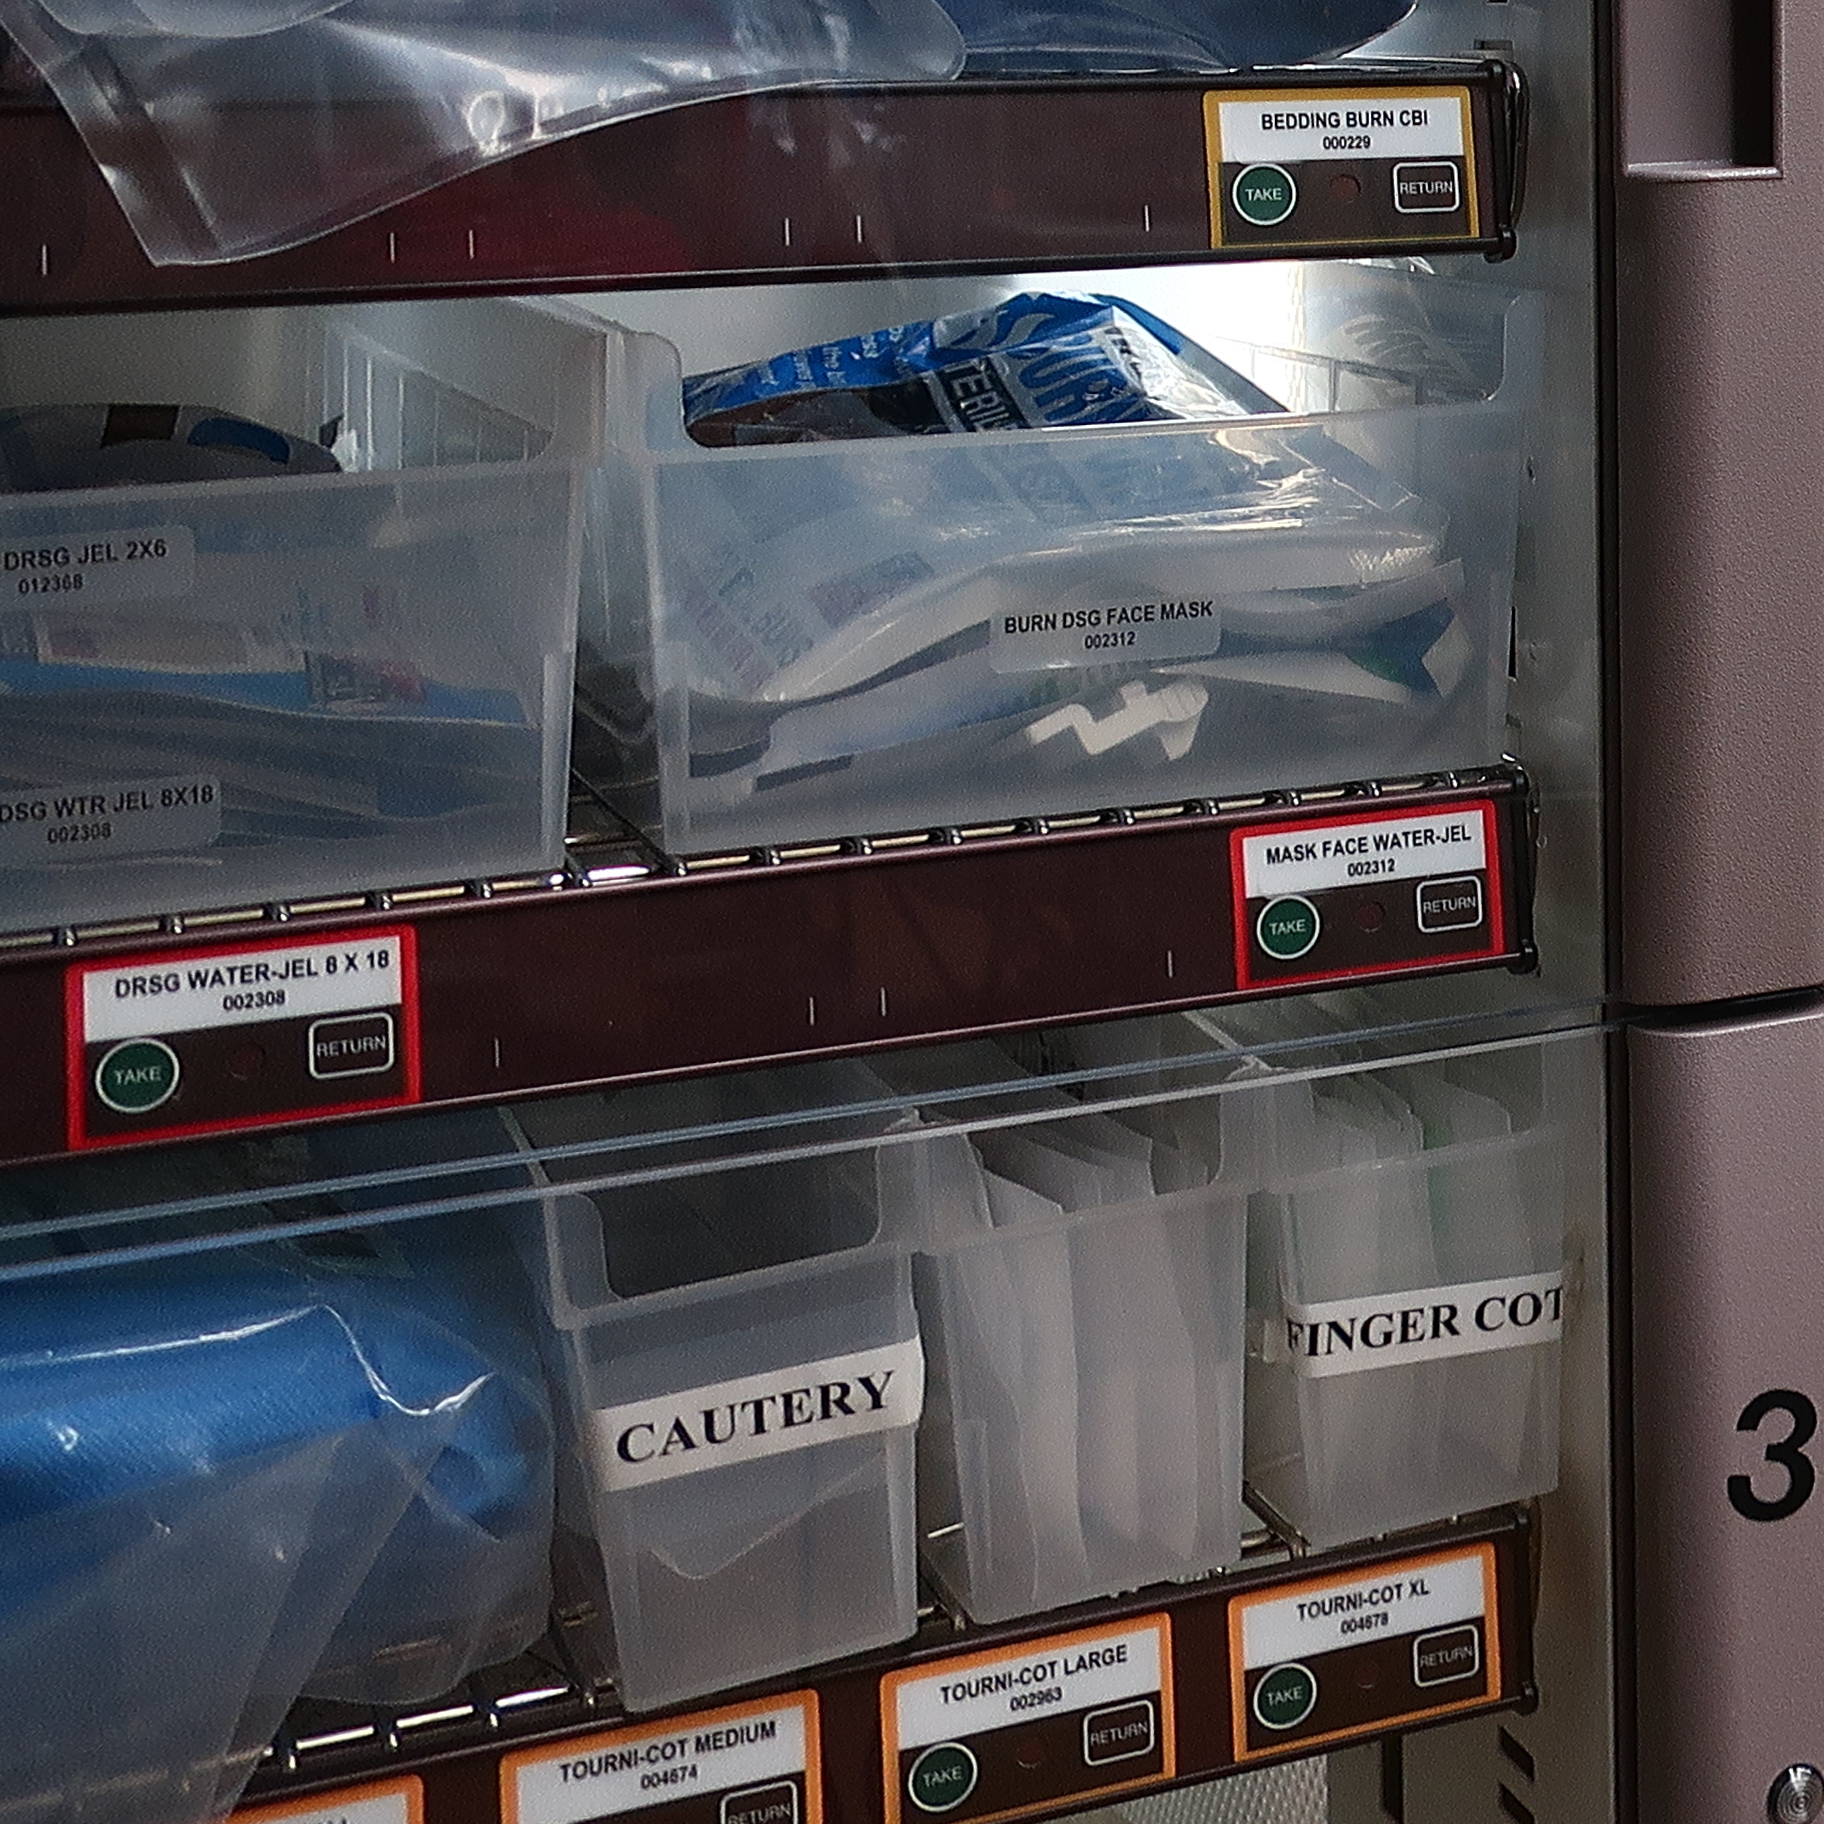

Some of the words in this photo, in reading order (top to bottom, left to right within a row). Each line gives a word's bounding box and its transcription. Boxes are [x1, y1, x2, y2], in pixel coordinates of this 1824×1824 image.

[1261, 112, 1340, 131] BEDDING
[1346, 110, 1394, 128] BURN
[1399, 109, 1428, 126] CBI
[1323, 135, 1371, 151] 000229
[1399, 181, 1453, 195] RETURN
[3, 546, 71, 572] DRSG
[78, 541, 118, 566] JEL
[126, 539, 167, 563] 2X6
[1004, 614, 1056, 636] BURN
[1061, 609, 1103, 630] DSG
[1106, 605, 1156, 626] FACE
[1160, 600, 1213, 621] MASK
[1083, 631, 1136, 651] 002312
[54, 796, 106, 818] WTR
[112, 790, 154, 814] JEL
[160, 785, 214, 809] 8X18
[1266, 844, 1317, 865] MASK
[1322, 837, 1369, 859] FACE
[1372, 825, 1471, 851] WATER-JEL
[1347, 859, 1395, 877] 002312
[1269, 919, 1307, 936] TAKE
[115, 974, 181, 1000] DRSG
[187, 957, 318, 990] WATER-JEL
[366, 949, 389, 969] 18
[1287, 1290, 1460, 1358] FINGER
[616, 1370, 893, 1465] CAUTERY
[1727, 1389, 1817, 1523] 3
[1297, 1583, 1402, 1621] TOURNI-COT
[1408, 1579, 1430, 1596] XL
[1420, 1646, 1473, 1669] RETURN
[940, 1660, 1058, 1705] TOURNI-COT
[1063, 1644, 1128, 1676] LARGE
[559, 1743, 691, 1784] TOURNI-COT
[694, 1720, 778, 1759] MEDIUM
[922, 1766, 964, 1788] TAKE
